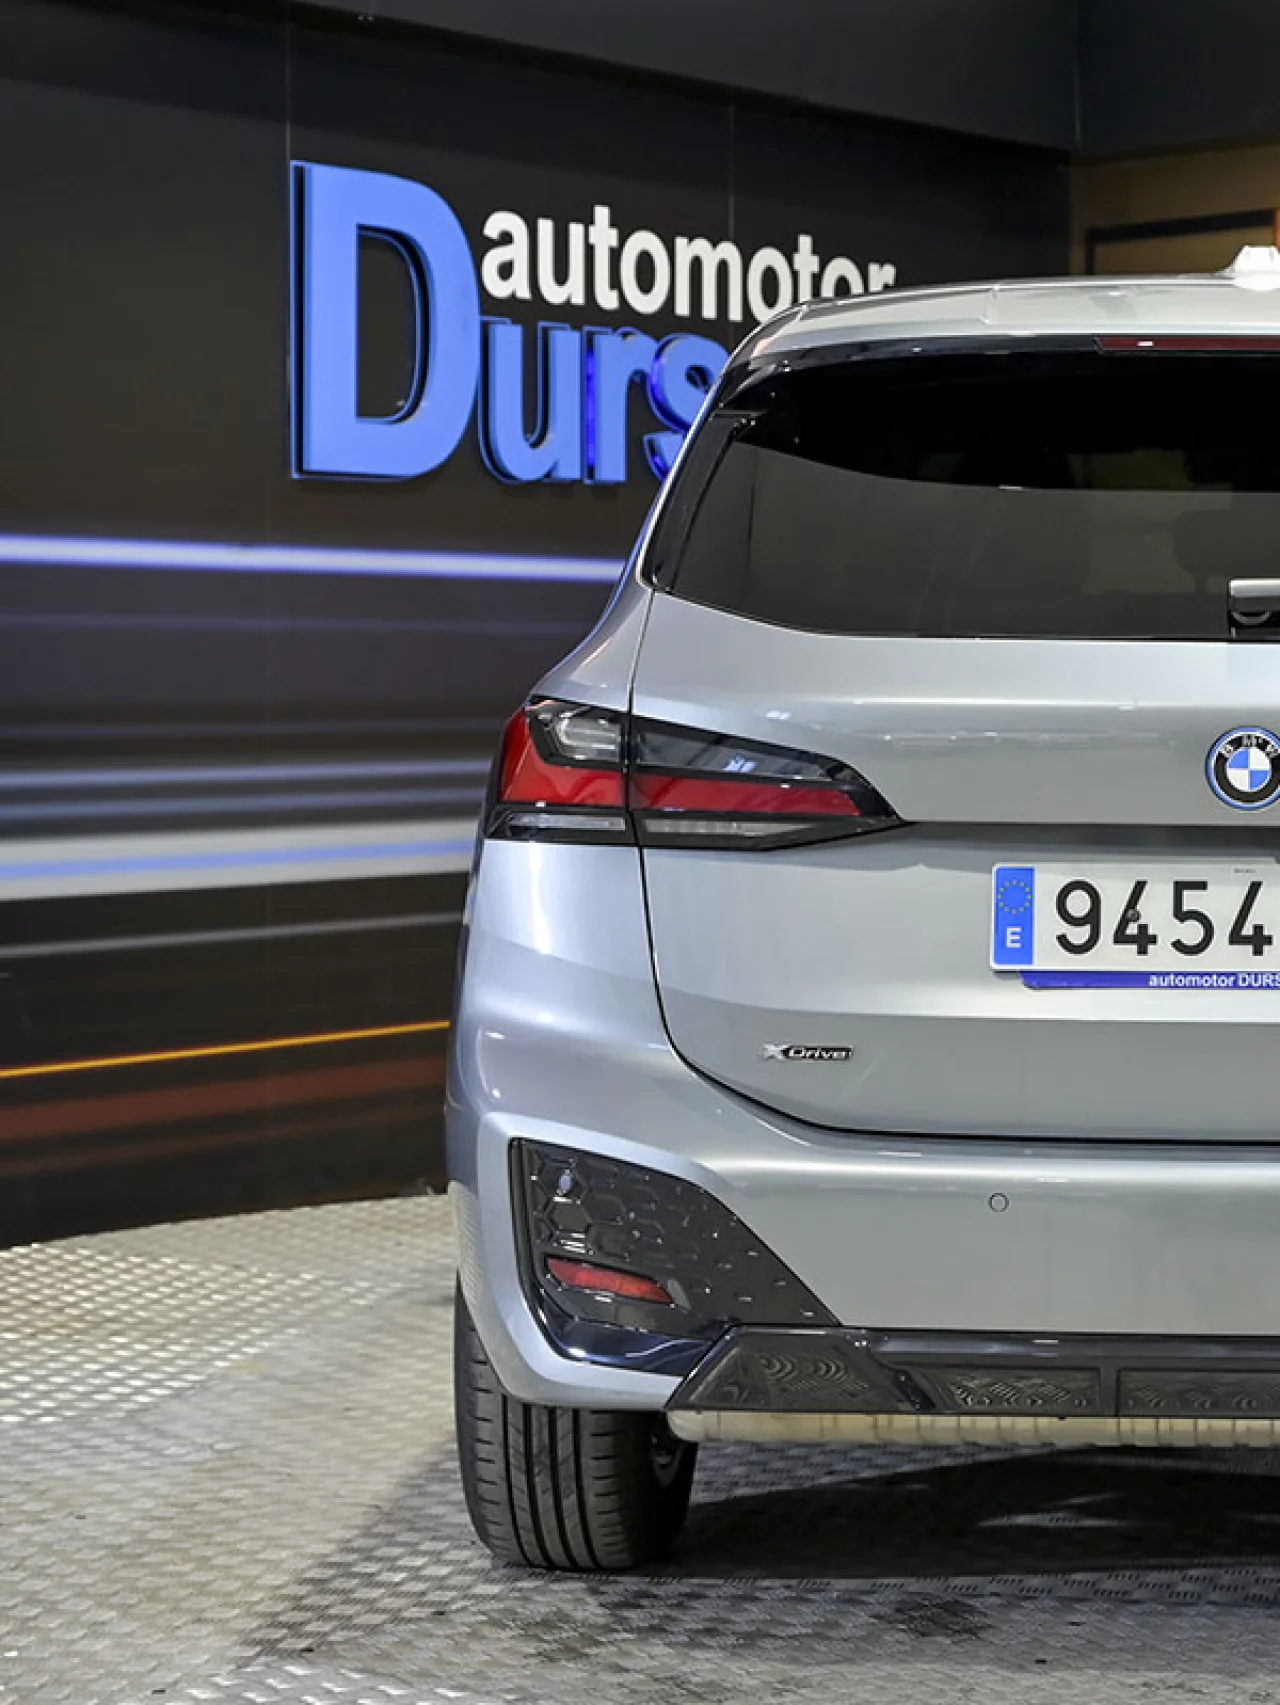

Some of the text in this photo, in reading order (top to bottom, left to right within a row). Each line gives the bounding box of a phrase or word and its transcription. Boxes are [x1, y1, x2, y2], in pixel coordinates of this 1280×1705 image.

[1055, 879, 1274, 957] 9454
[1005, 927, 1021, 948] E
[1148, 973, 1235, 988] automotor
